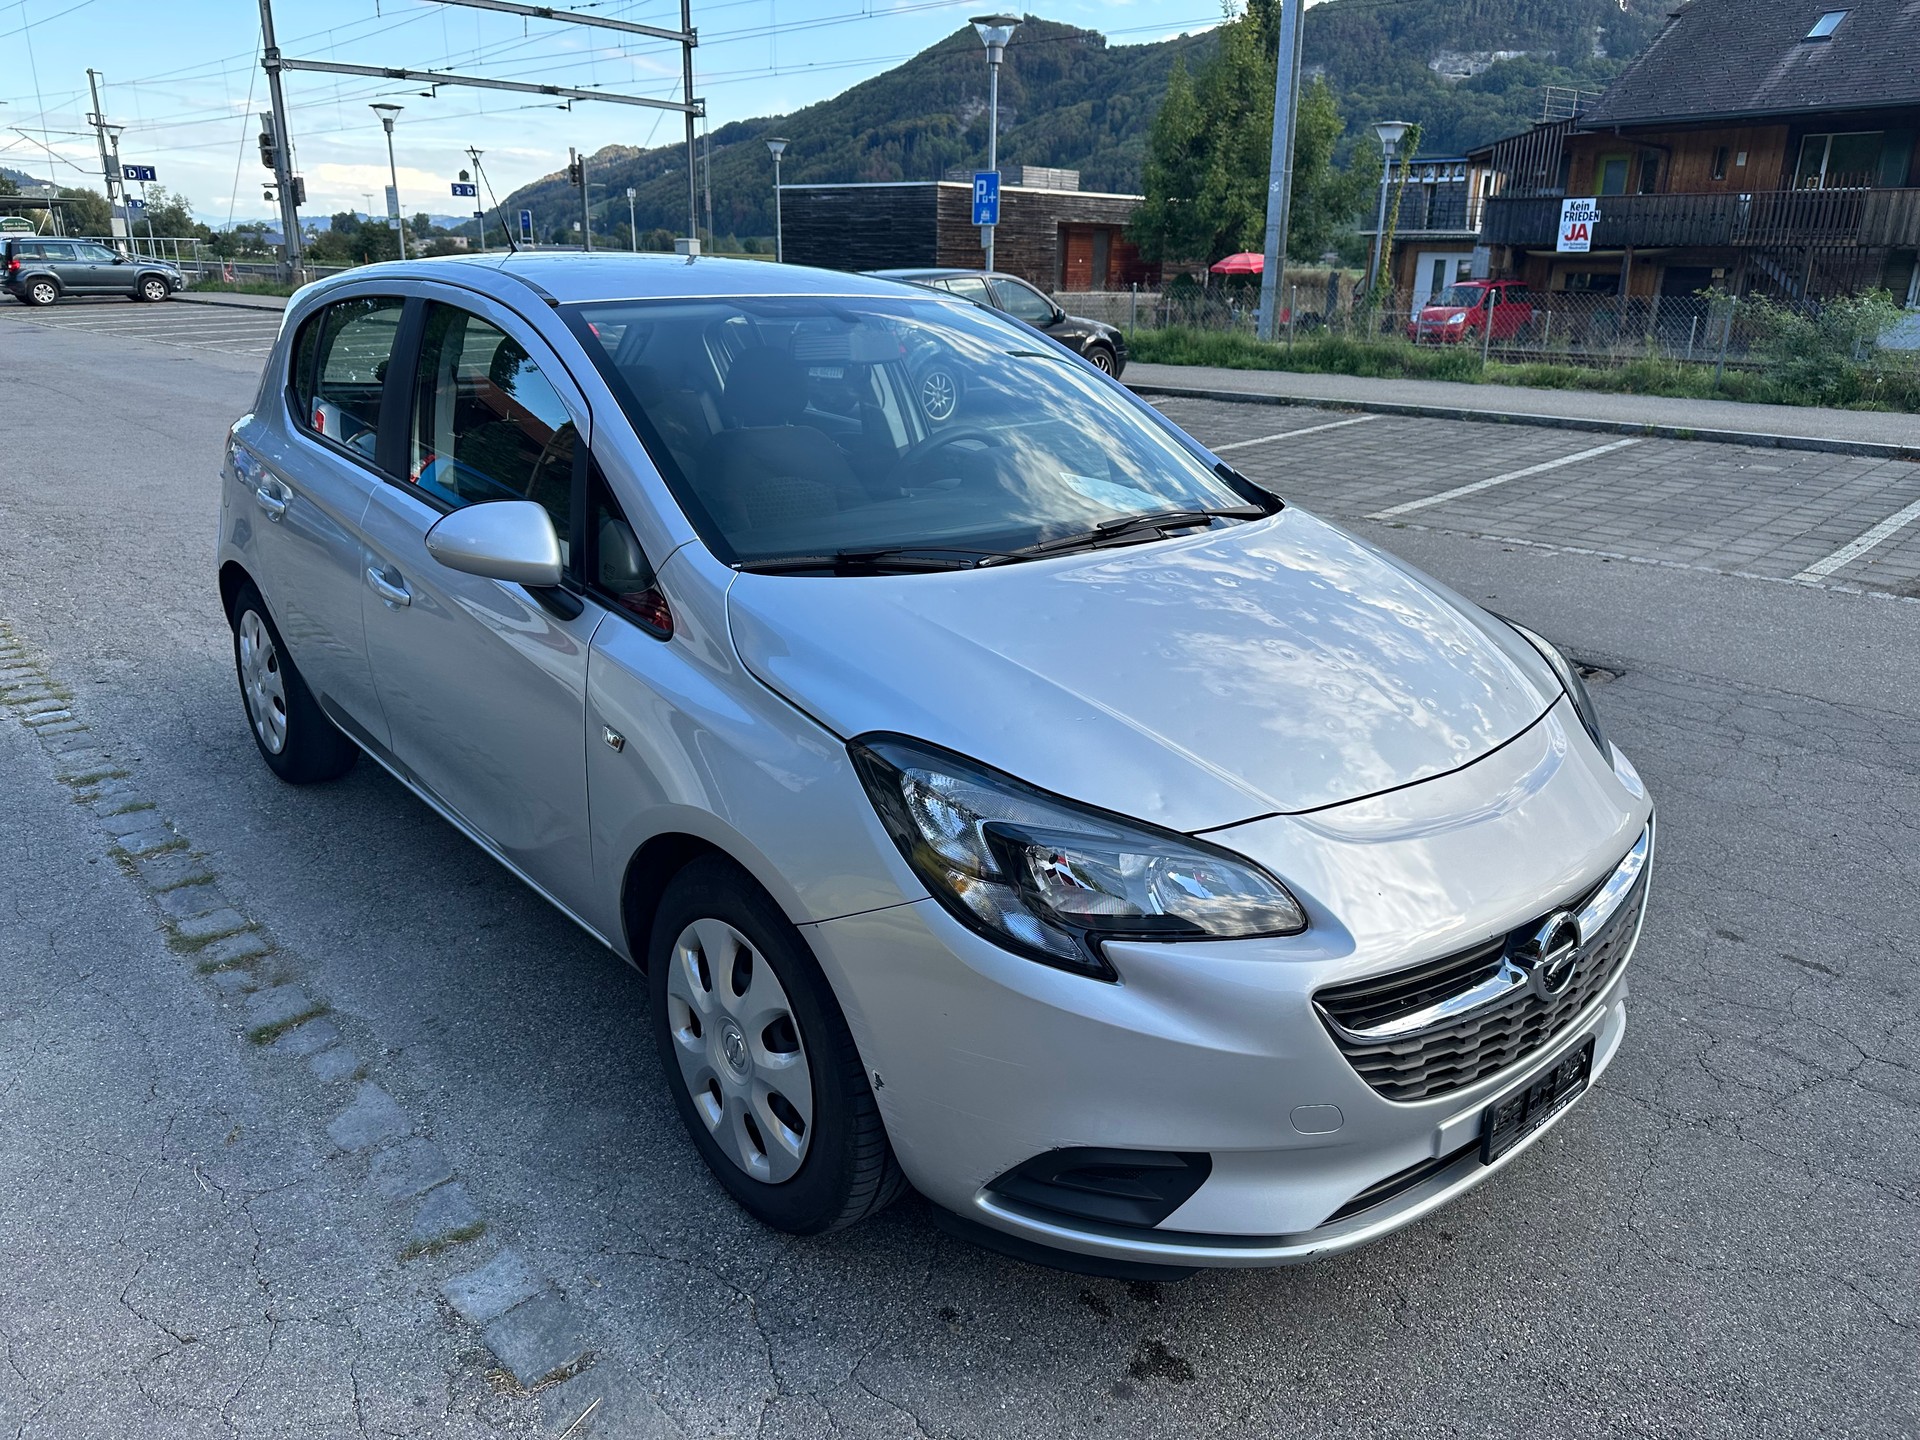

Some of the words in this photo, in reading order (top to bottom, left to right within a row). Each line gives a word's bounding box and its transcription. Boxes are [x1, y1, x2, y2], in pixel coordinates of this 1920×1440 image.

[128, 169, 137, 178] D
[145, 170, 151, 179] 1
[455, 187, 462, 195] 2
[466, 187, 474, 195] D
[975, 179, 987, 204] P
[1570, 201, 1590, 211] Kein
[1563, 210, 1599, 222] FRIEDEN
[1564, 223, 1589, 241] JA
[1535, 1100, 1567, 1128] TOURING
